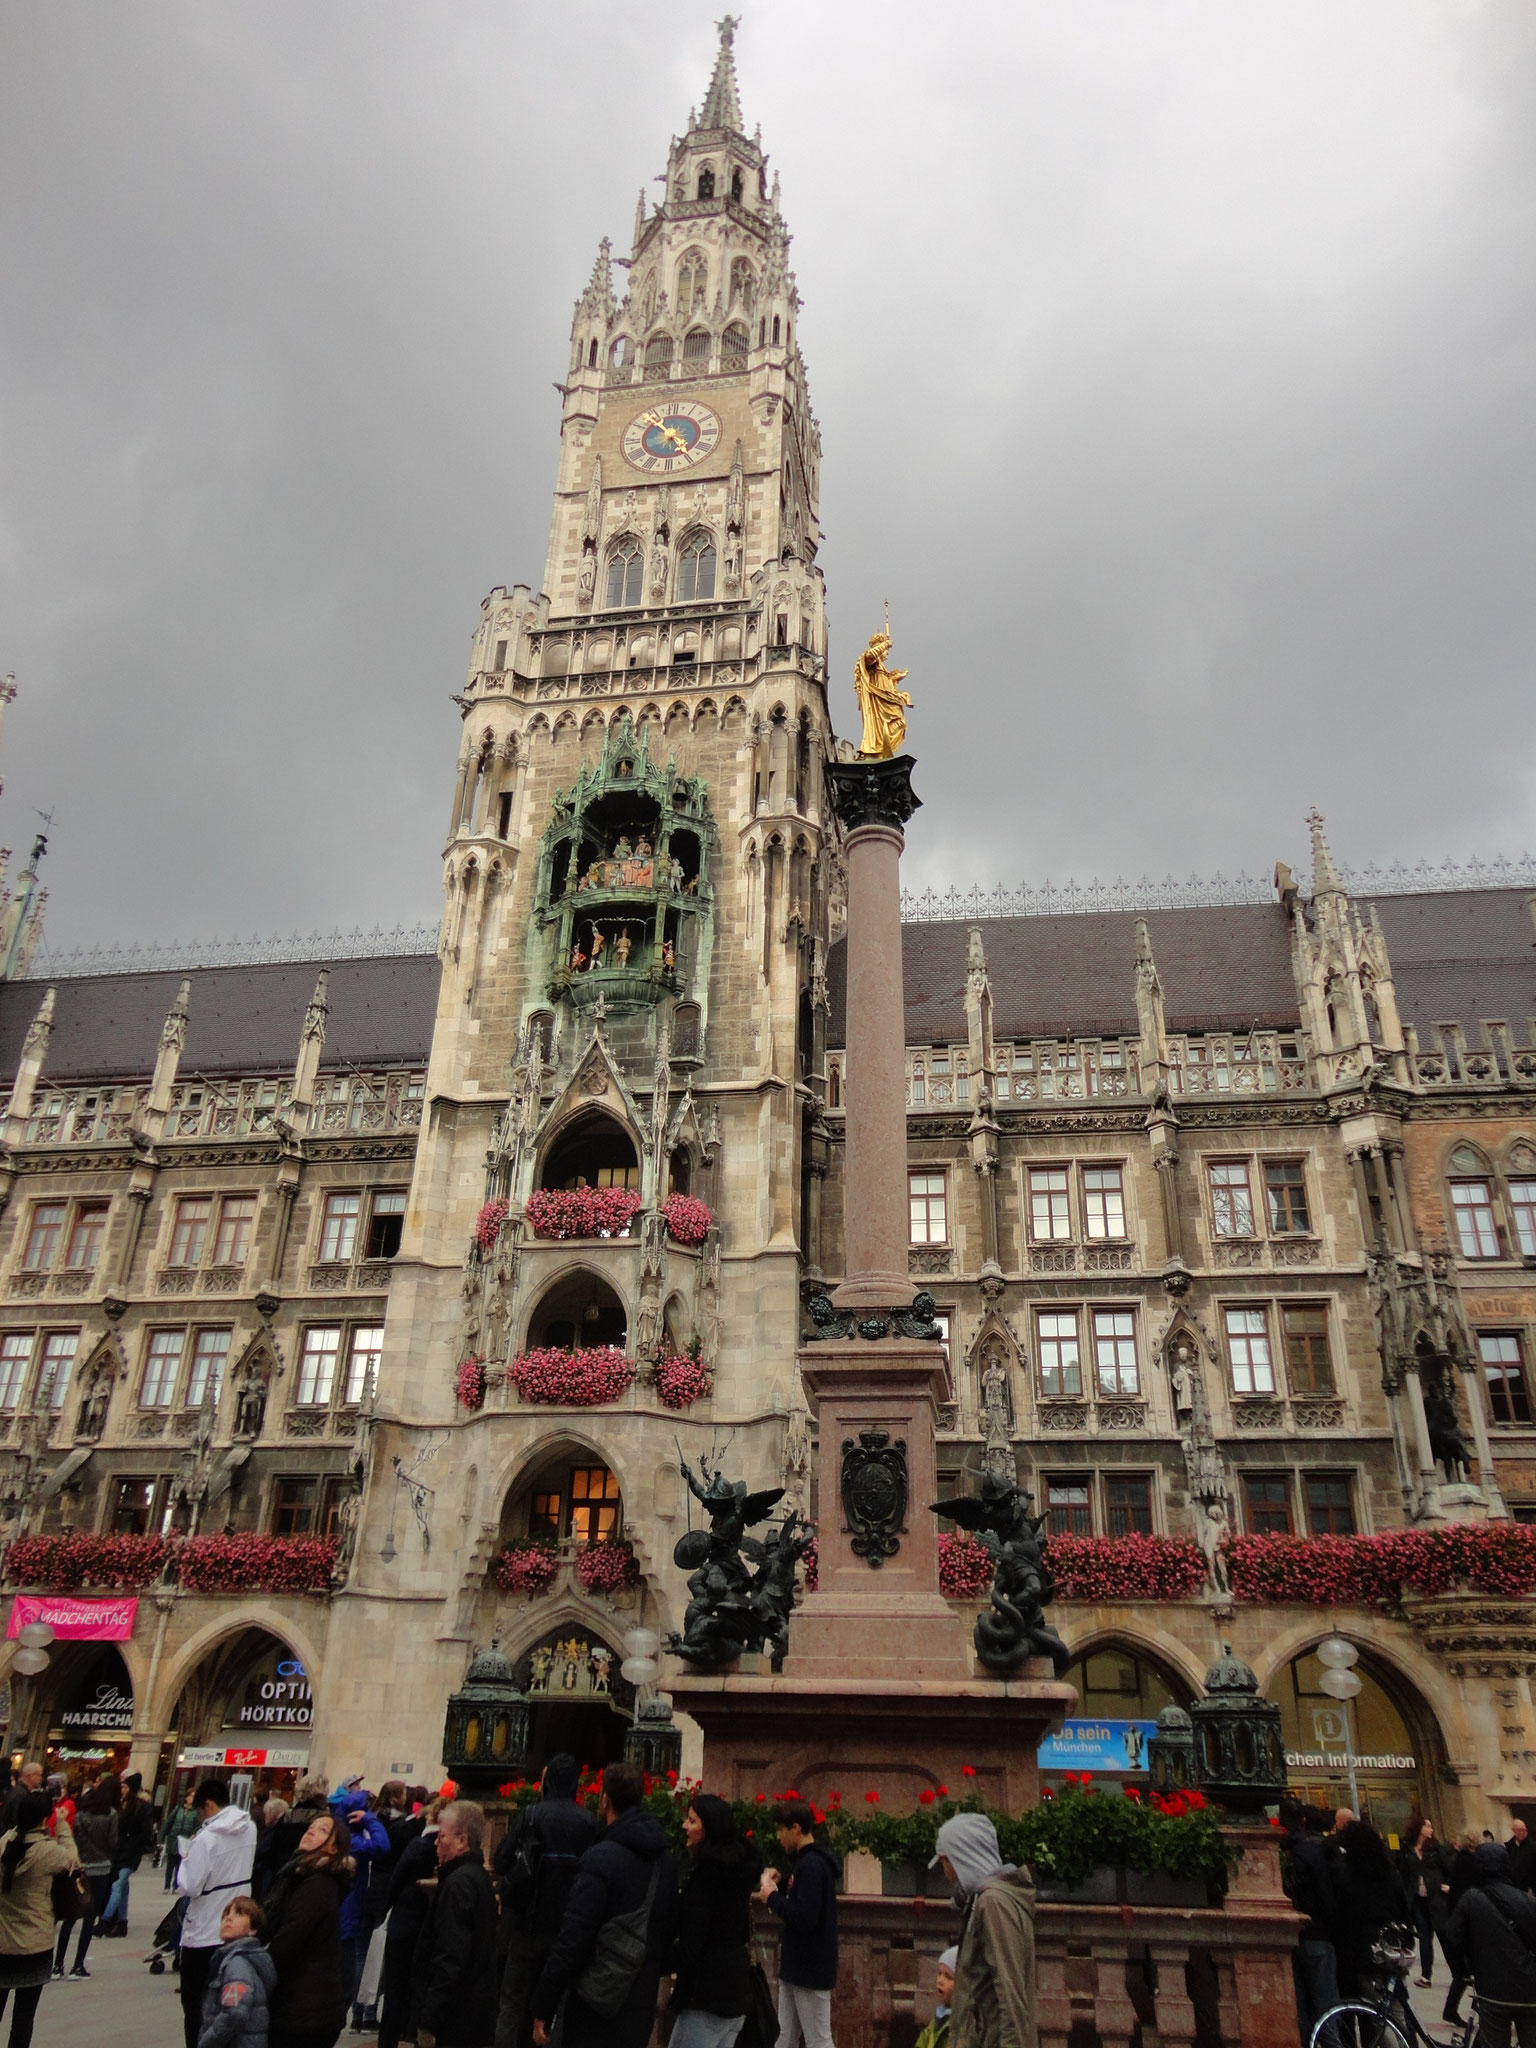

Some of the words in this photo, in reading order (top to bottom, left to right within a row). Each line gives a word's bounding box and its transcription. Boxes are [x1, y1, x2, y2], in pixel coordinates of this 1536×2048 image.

[261, 1682, 313, 1700] OPTI
[240, 1705, 315, 1723] HÖRTKO
[1077, 1725, 1111, 1741] sein
[1053, 1741, 1102, 1753] München
[1286, 1751, 1324, 1767] chen
[1329, 1753, 1416, 1769] Information
